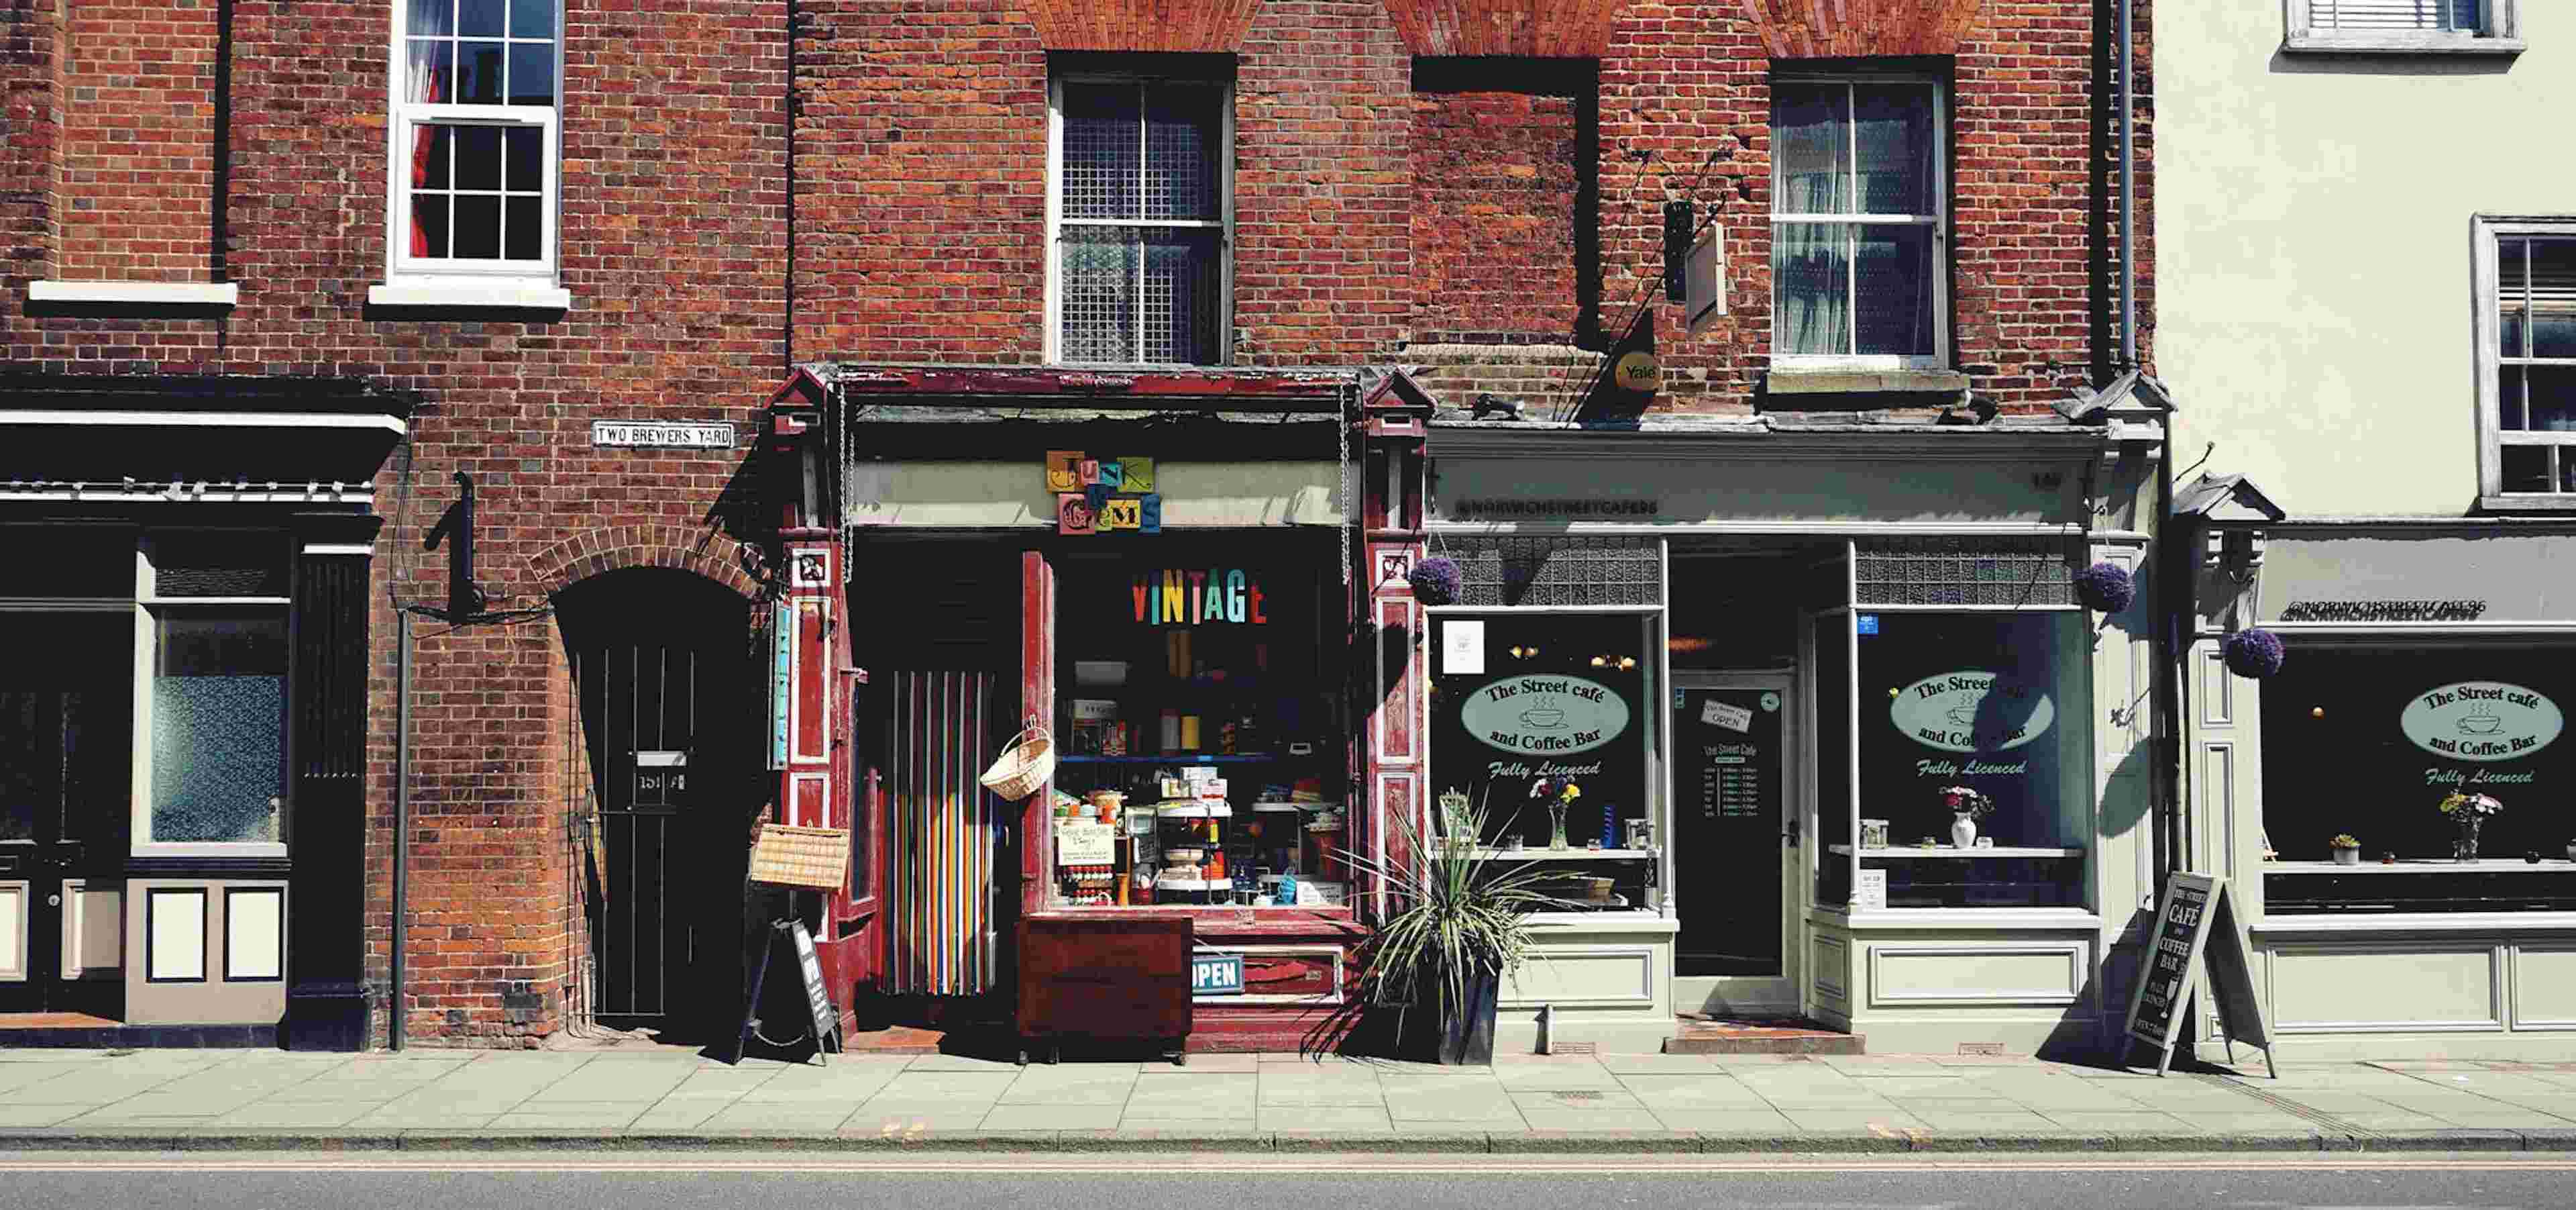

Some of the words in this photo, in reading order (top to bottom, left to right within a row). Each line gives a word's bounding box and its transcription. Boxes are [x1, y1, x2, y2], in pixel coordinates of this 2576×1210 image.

[1626, 366, 1656, 381] Yale
[598, 427, 627, 443] TWO
[632, 427, 691, 444] BREWERS
[698, 429, 729, 444] YARD
[1132, 569, 1267, 625] VINTAGE
[1485, 684, 1517, 702] The
[1521, 679, 1568, 694] Street
[1572, 684, 1605, 703] café
[1914, 682, 1945, 700] The
[2424, 692, 2455, 709] The
[2457, 686, 2504, 701] Street
[2507, 691, 2539, 709] café
[1712, 713, 1739, 727] OPEN
[1490, 730, 1518, 746] and
[1522, 736, 1571, 750] Coffee
[1574, 729, 1601, 746] Bar
[1919, 727, 1946, 744] and
[2429, 737, 2457, 753] and
[2460, 740, 2508, 756] Coffee
[2510, 736, 2536, 752] Bar
[1487, 761, 1530, 780] Fully
[1916, 758, 1959, 778] Fully
[2425, 768, 2466, 786] Fully
[639, 776, 660, 789] 151
[2169, 903, 2202, 927] CAFÉ
[2159, 936, 2190, 957] COFFEE
[2159, 954, 2179, 972] BAR
